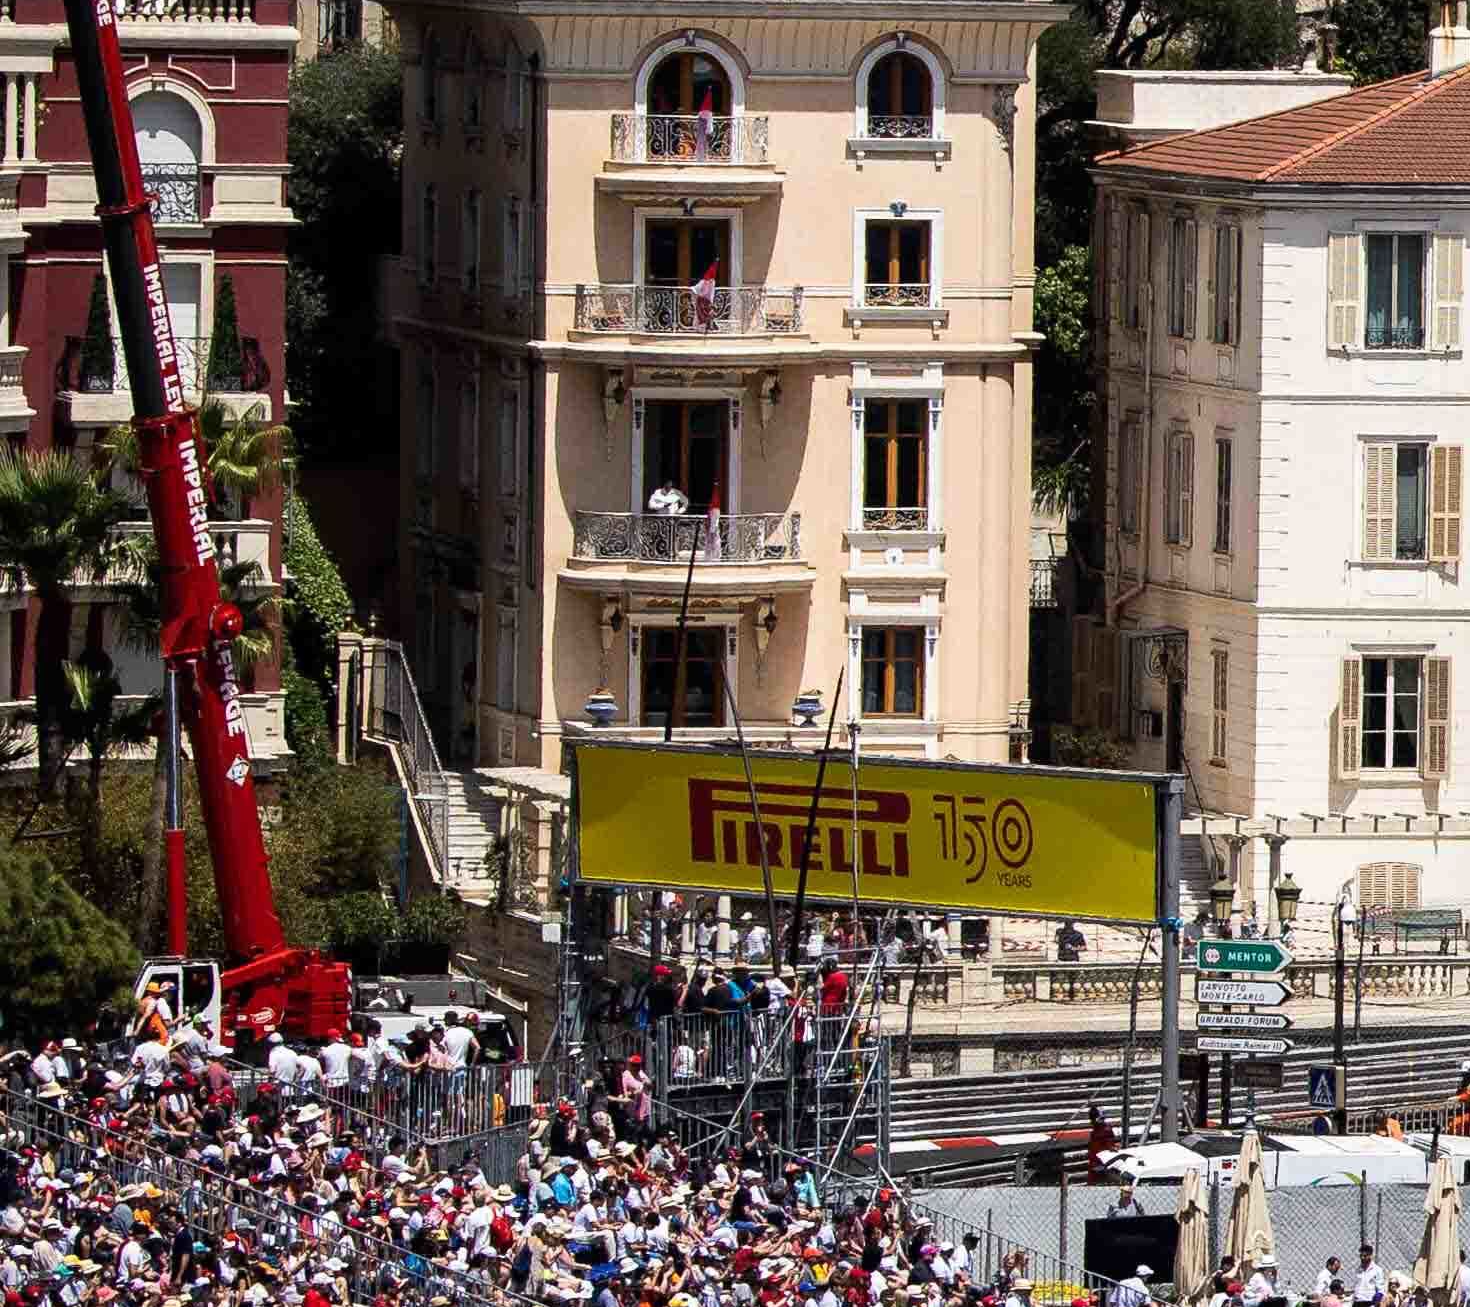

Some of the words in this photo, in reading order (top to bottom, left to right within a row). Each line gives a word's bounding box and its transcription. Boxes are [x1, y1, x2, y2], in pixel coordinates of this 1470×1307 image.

[143, 262, 175, 371] IMPERIAL
[178, 437, 208, 568] IMPERIAL
[687, 777, 912, 879] PIRELLI
[932, 792, 1034, 884] 150
[996, 871, 1034, 887] YEARS
[1199, 1015, 1244, 1026] GRIMALDI
[1247, 1016, 1281, 1026] FORUM
[1200, 992, 1265, 1002] MONTE-CARLO
